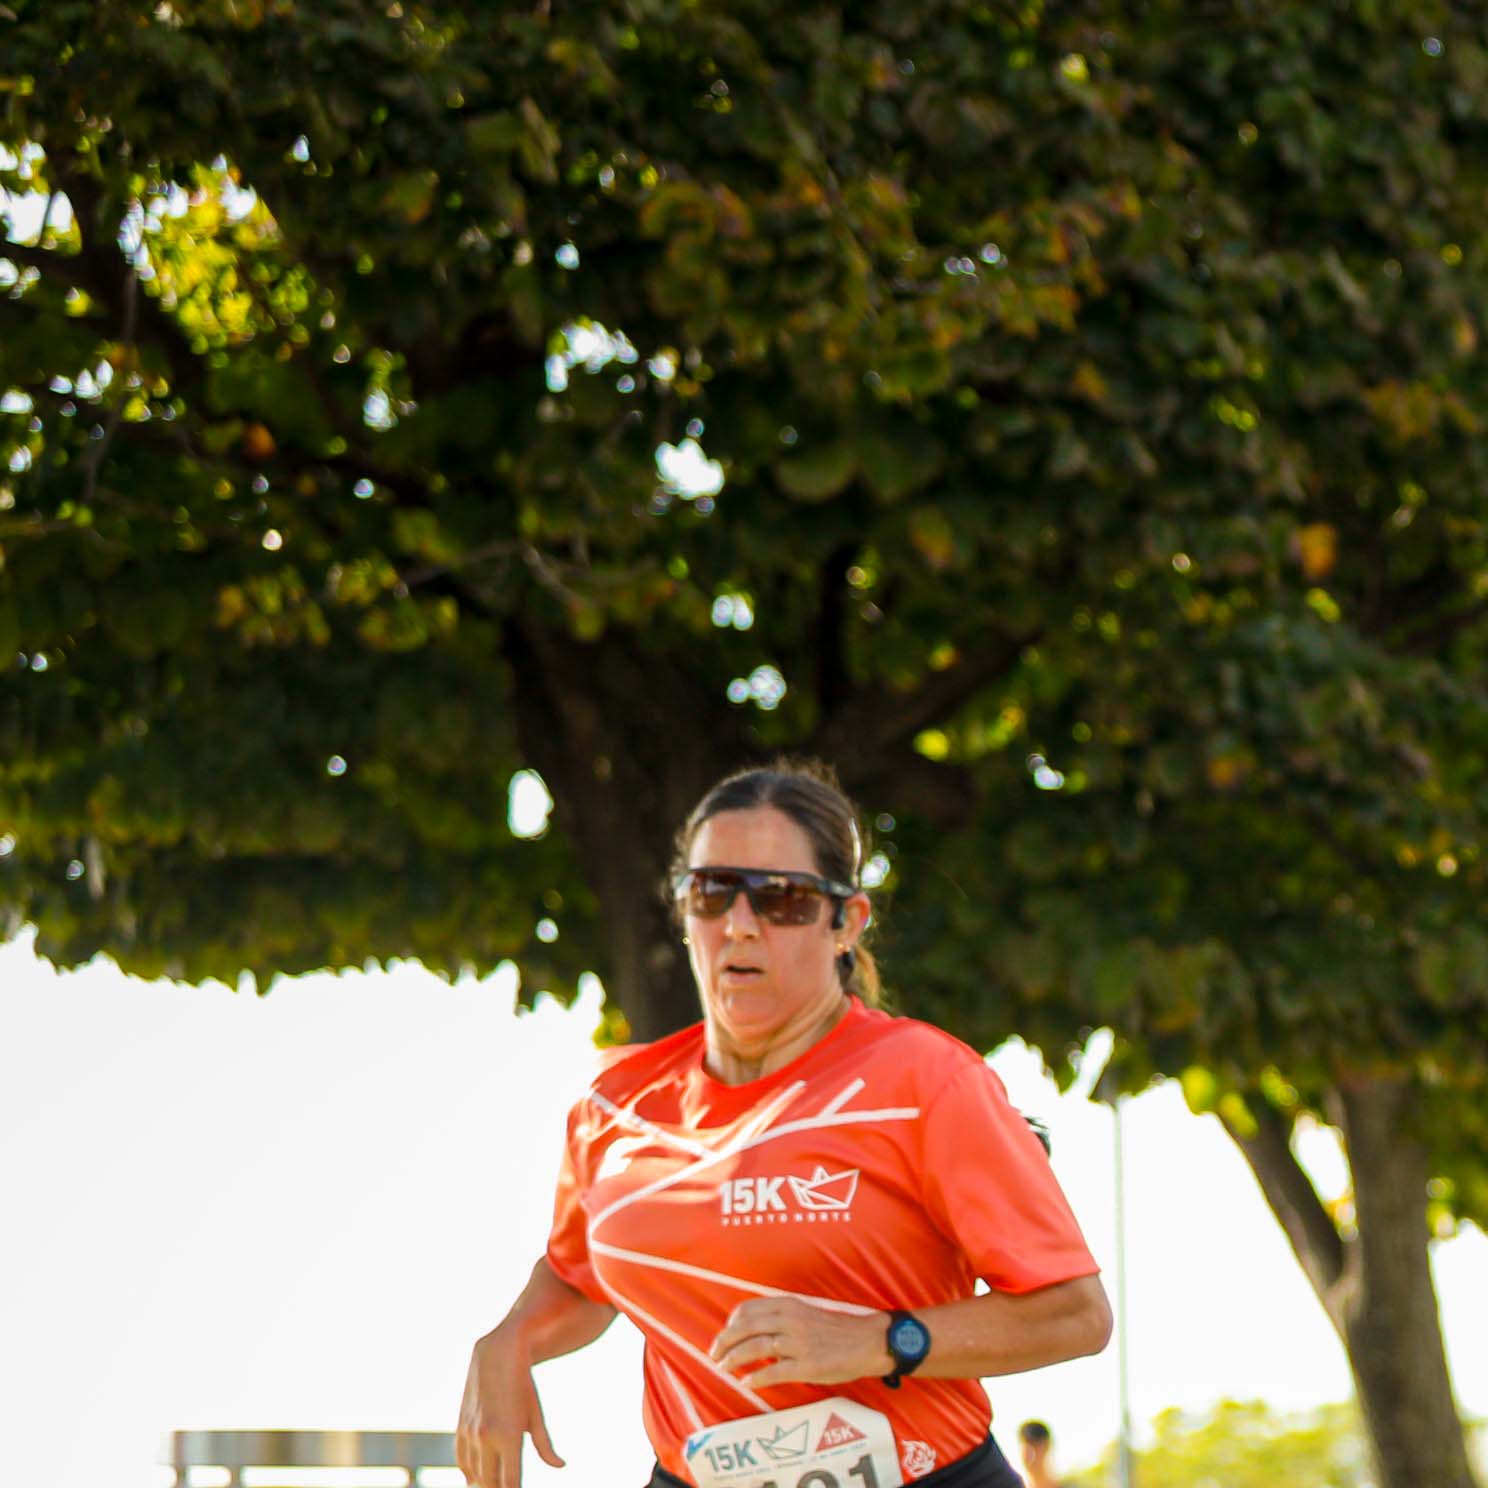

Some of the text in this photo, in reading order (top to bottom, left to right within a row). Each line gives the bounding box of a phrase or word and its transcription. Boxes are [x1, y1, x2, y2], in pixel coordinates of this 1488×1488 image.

[720, 1176, 787, 1214] 15K
[721, 1211, 852, 1227] PUERTO NORTE
[823, 1426, 855, 1445] 15K
[704, 1440, 758, 1473] 15K
